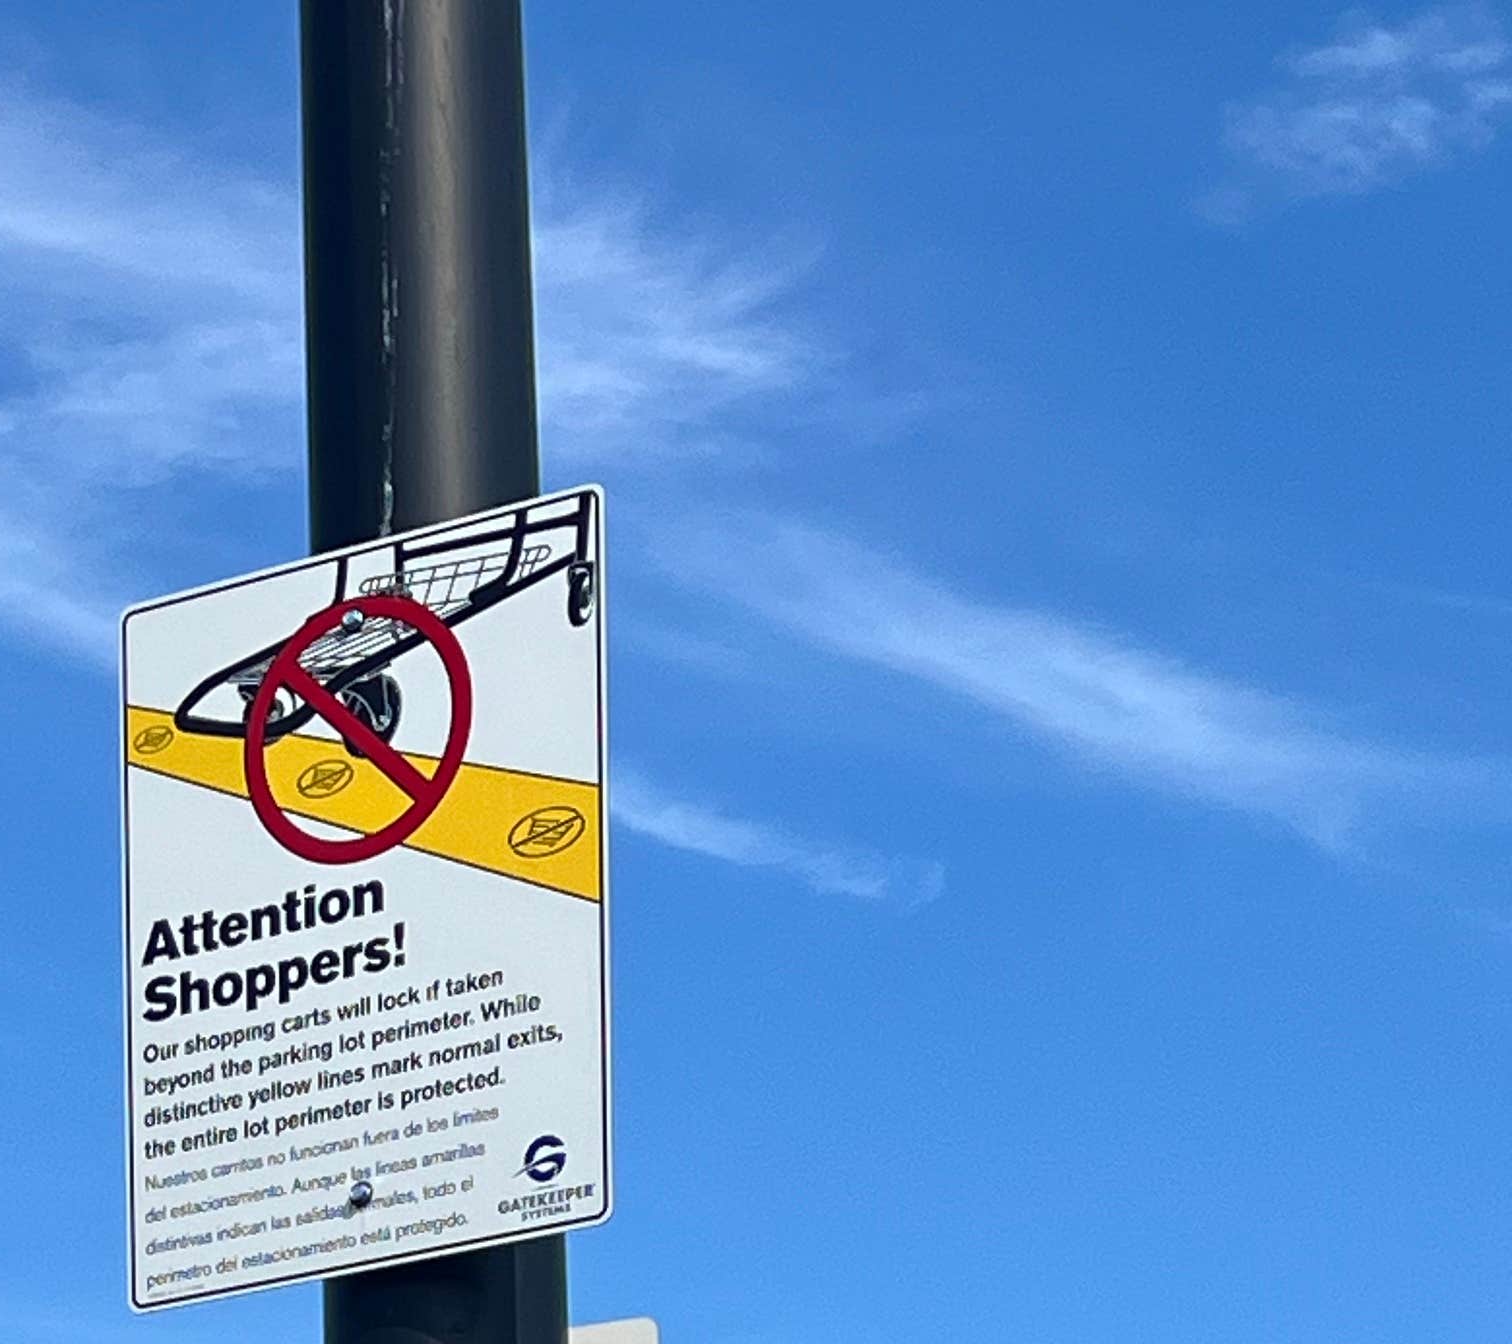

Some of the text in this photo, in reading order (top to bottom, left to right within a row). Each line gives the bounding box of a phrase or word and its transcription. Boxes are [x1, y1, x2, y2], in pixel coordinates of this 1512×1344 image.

[142, 879, 384, 967] Attention
[143, 922, 405, 1021] Shoppers!
[143, 970, 503, 1063] Our shopping carts will lock if taken
[144, 993, 542, 1096] beyond the parking lot perimeter. While
[144, 1023, 563, 1128] distinctive yellow lines mark normal exits,
[144, 1066, 506, 1160] the entire lot perimeter is protected.
[267, 1152, 286, 1167] no
[403, 1120, 423, 1138] de
[145, 1205, 167, 1224] del
[291, 1172, 347, 1194] Aunque
[498, 1184, 594, 1214] GATEKEEPER
[521, 1204, 571, 1222] SYSTEMS
